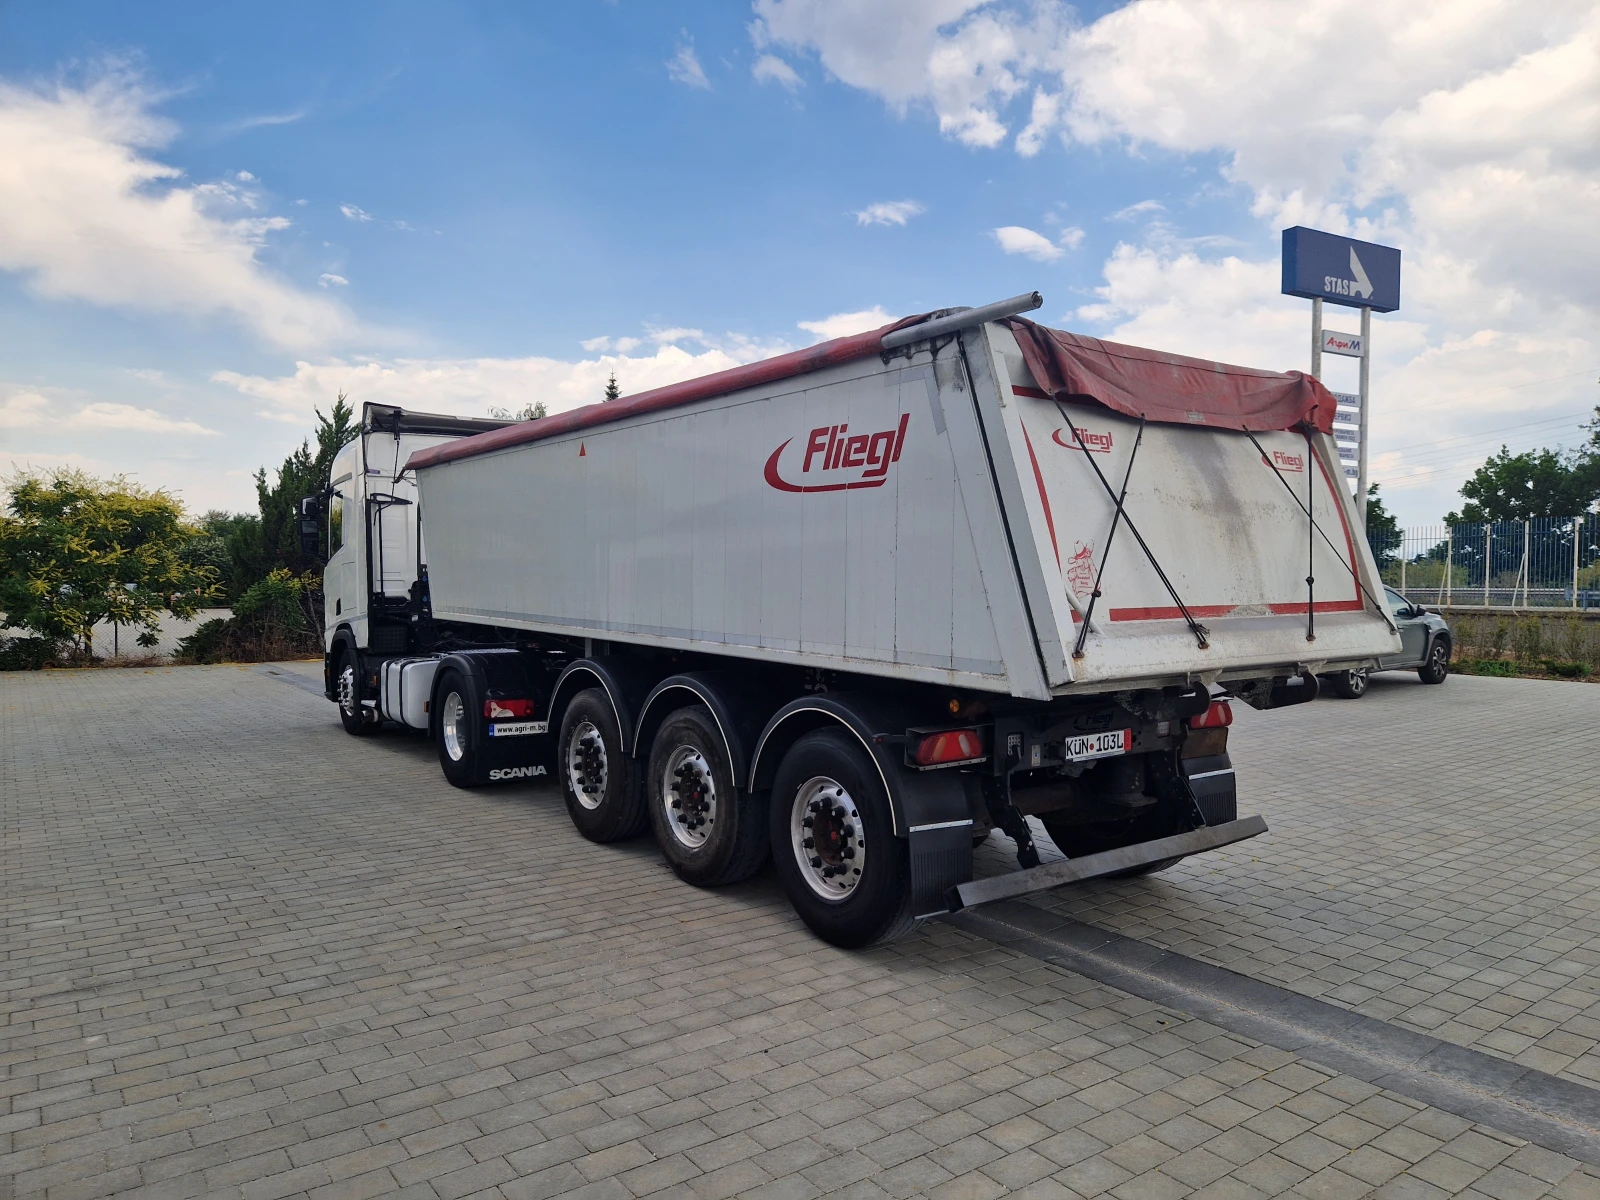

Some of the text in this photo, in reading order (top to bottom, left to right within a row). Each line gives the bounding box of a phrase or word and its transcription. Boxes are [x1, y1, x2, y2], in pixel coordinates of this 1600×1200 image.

[1324, 276, 1349, 295] STAS
[803, 413, 910, 477] Fliegl
[1273, 451, 1304, 470] Fliegl
[1085, 710, 1114, 726] Fliegl
[497, 724, 546, 733] www.agri-m.bg
[1066, 738, 1089, 756] KÜN
[1096, 733, 1124, 752] 103L
[489, 765, 547, 780] SCANIA
